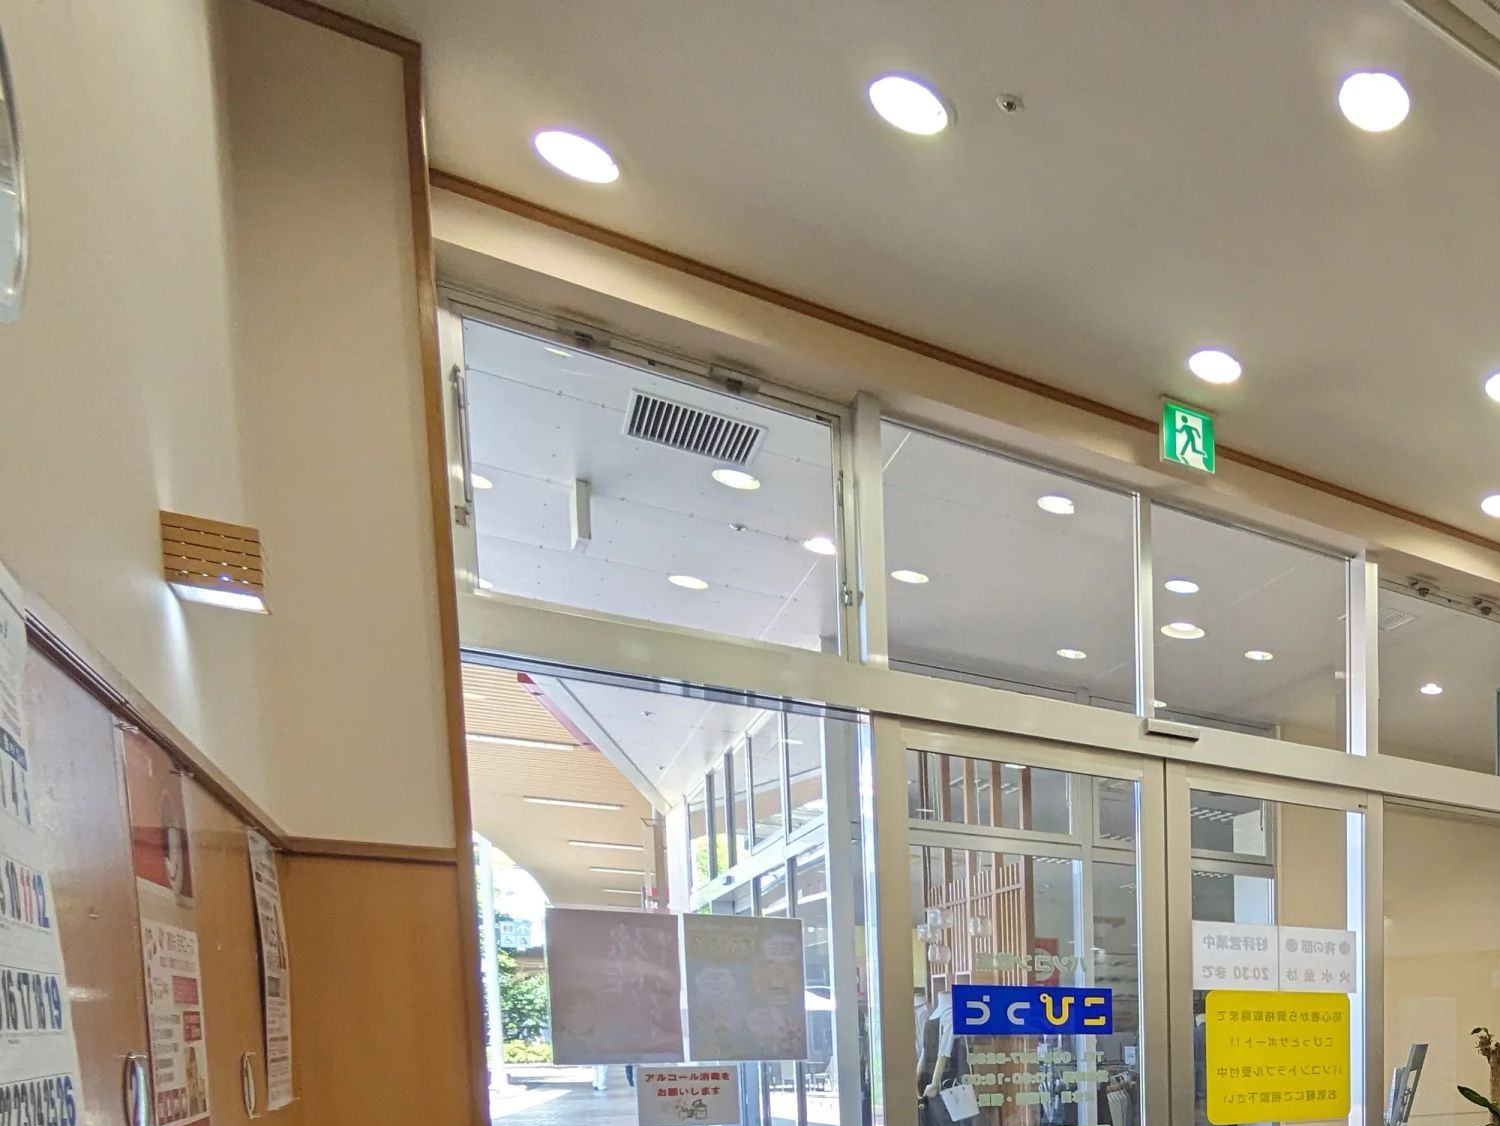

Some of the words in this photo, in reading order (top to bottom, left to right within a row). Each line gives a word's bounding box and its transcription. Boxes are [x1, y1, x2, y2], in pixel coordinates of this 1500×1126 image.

[33, 873, 50, 929] 12
[17, 972, 32, 1030] 17
[45, 976, 63, 1030] 19
[645, 1072, 730, 1082] アルコール消毒を
[657, 1086, 720, 1097] お願いします
